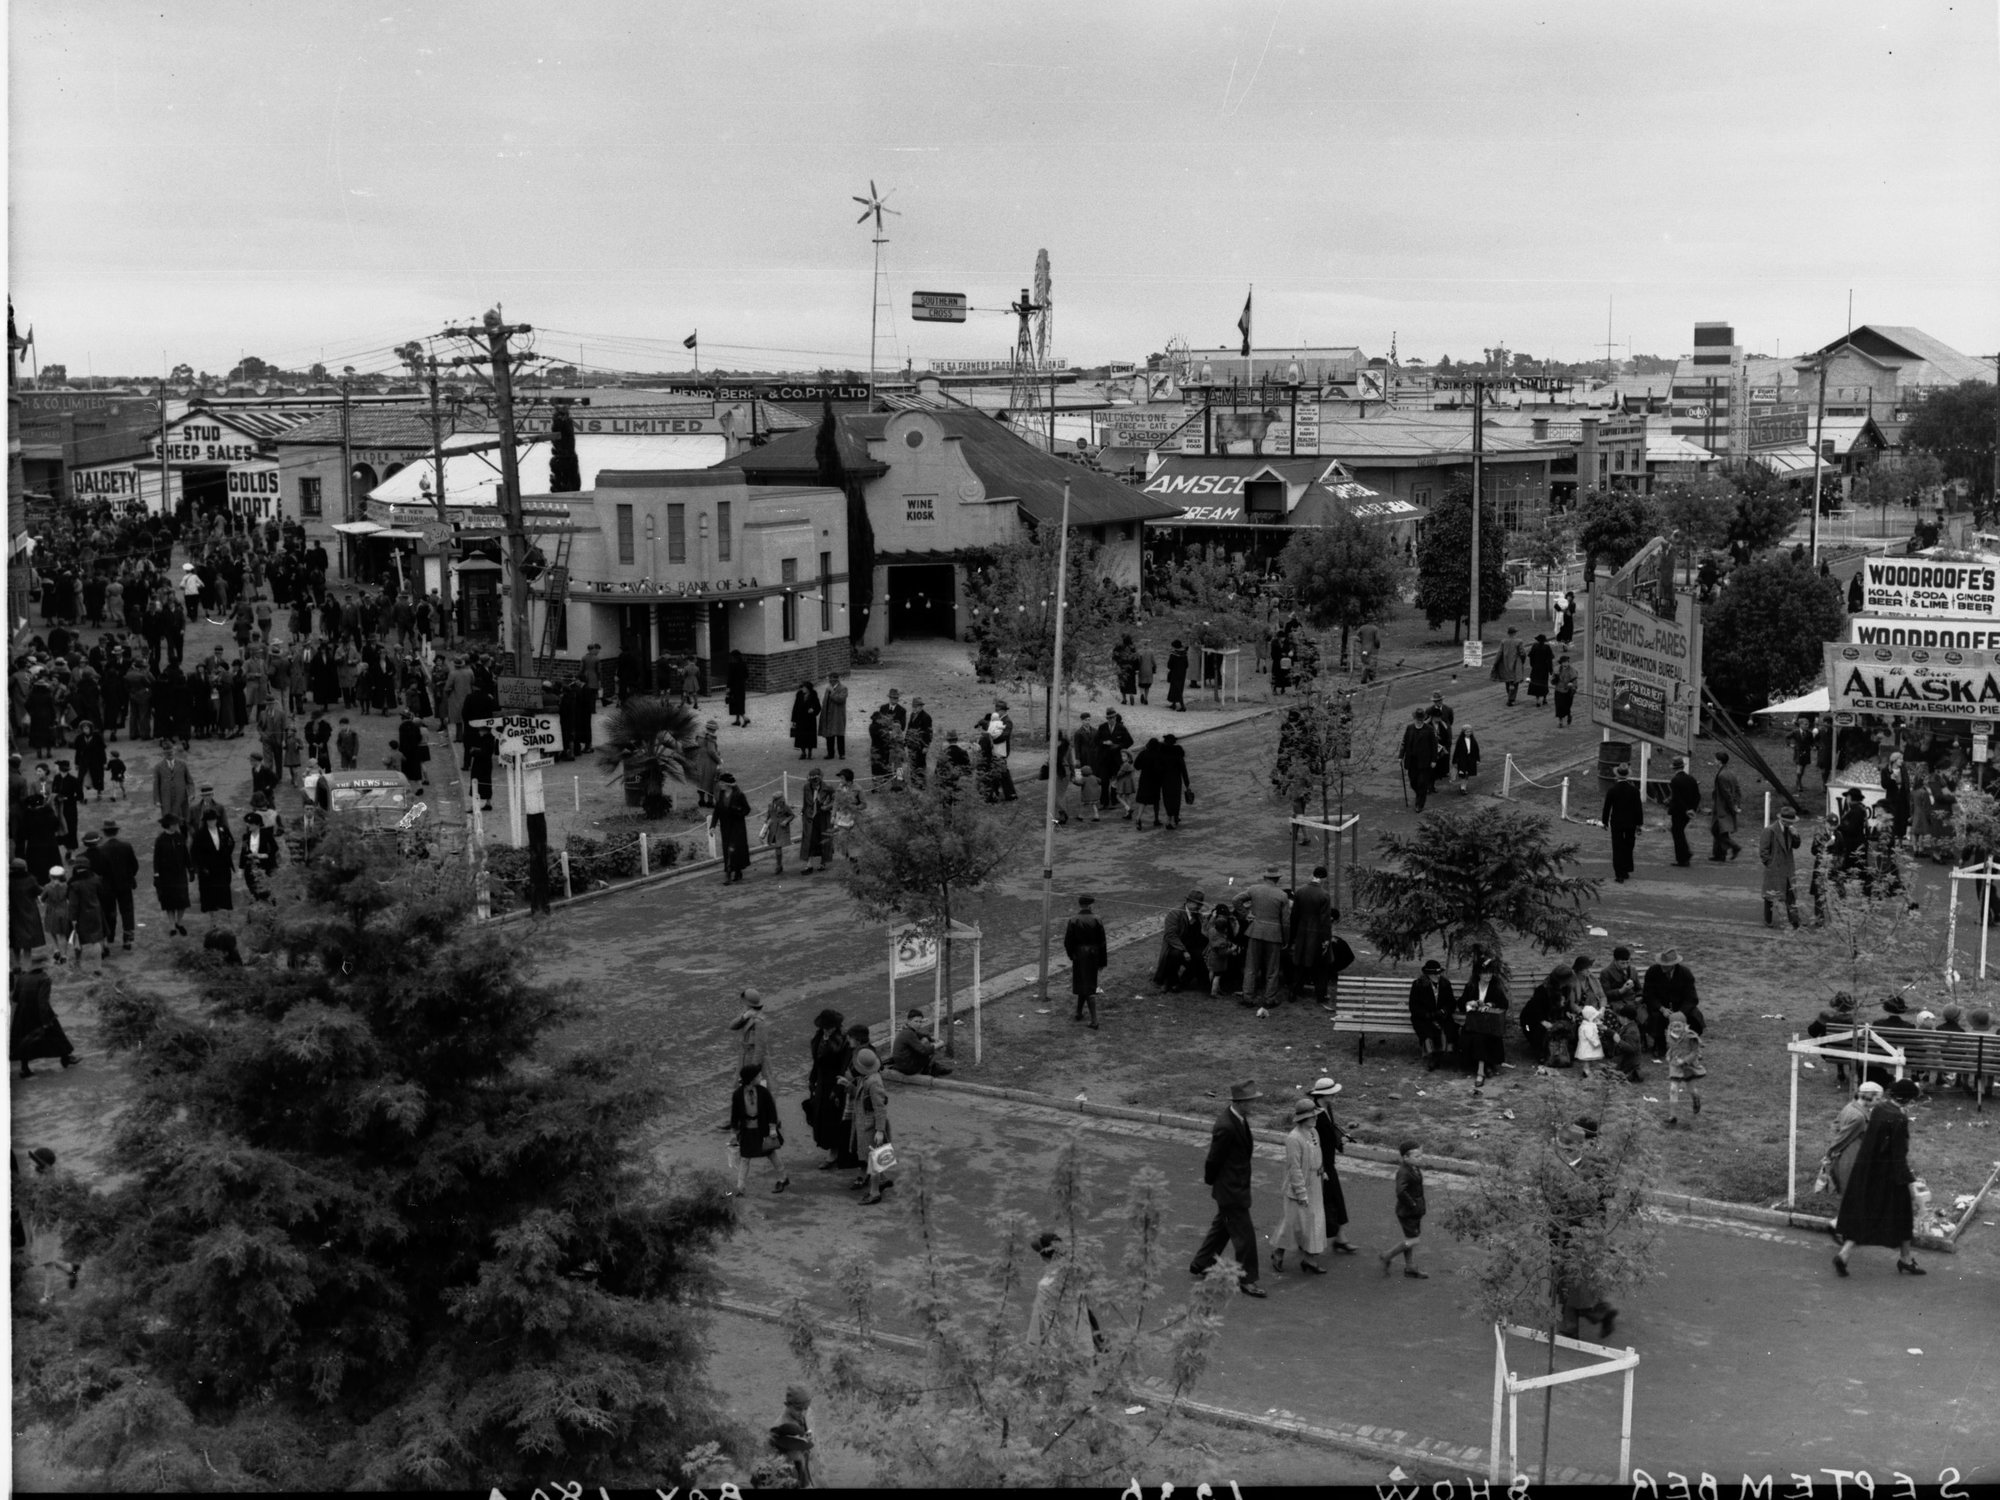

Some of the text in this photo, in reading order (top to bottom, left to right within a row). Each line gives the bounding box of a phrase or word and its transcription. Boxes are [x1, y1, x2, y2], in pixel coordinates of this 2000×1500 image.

[920, 296, 958, 306] SOUTHERN
[928, 308, 953, 318] CROSS
[1111, 365, 1134, 373] COMET
[720, 388, 763, 399] BERR
[769, 390, 780, 399] &
[839, 387, 868, 398] LTD
[1207, 387, 1291, 405] AMSCOL
[613, 419, 703, 432] LIMITED
[184, 425, 220, 441] STUD
[156, 444, 253, 461] SHEEP SALES
[74, 471, 137, 494] DALGETY
[228, 471, 279, 493] GOLDS
[907, 499, 934, 510] WINE
[906, 510, 935, 521] KIOSK
[1868, 564, 1996, 591] WOODROOFE'S
[678, 581, 711, 593] BANK
[716, 578, 733, 591] OF
[1868, 588, 1903, 598] KOLA
[1912, 590, 1948, 600] SODA
[1956, 593, 1995, 603] GINGER
[1868, 597, 1903, 607] BEER
[1909, 600, 1949, 609] & LIME
[1957, 602, 1993, 612] BEER
[1601, 615, 1645, 648] FREIGHTS
[1655, 629, 1687, 659] FARES
[1595, 643, 1621, 664] RAILWAY
[1621, 647, 1657, 674] INFORMATION
[1843, 666, 2000, 703] ALASKA
[1852, 698, 1873, 708] ICE
[1875, 700, 1920, 711] CREAM
[1927, 703, 1975, 714] ESKIMO
[502, 717, 551, 730] PUBLIC
[507, 728, 536, 738] GRAND
[522, 733, 555, 746] STAND
[353, 779, 380, 787] NEWS
